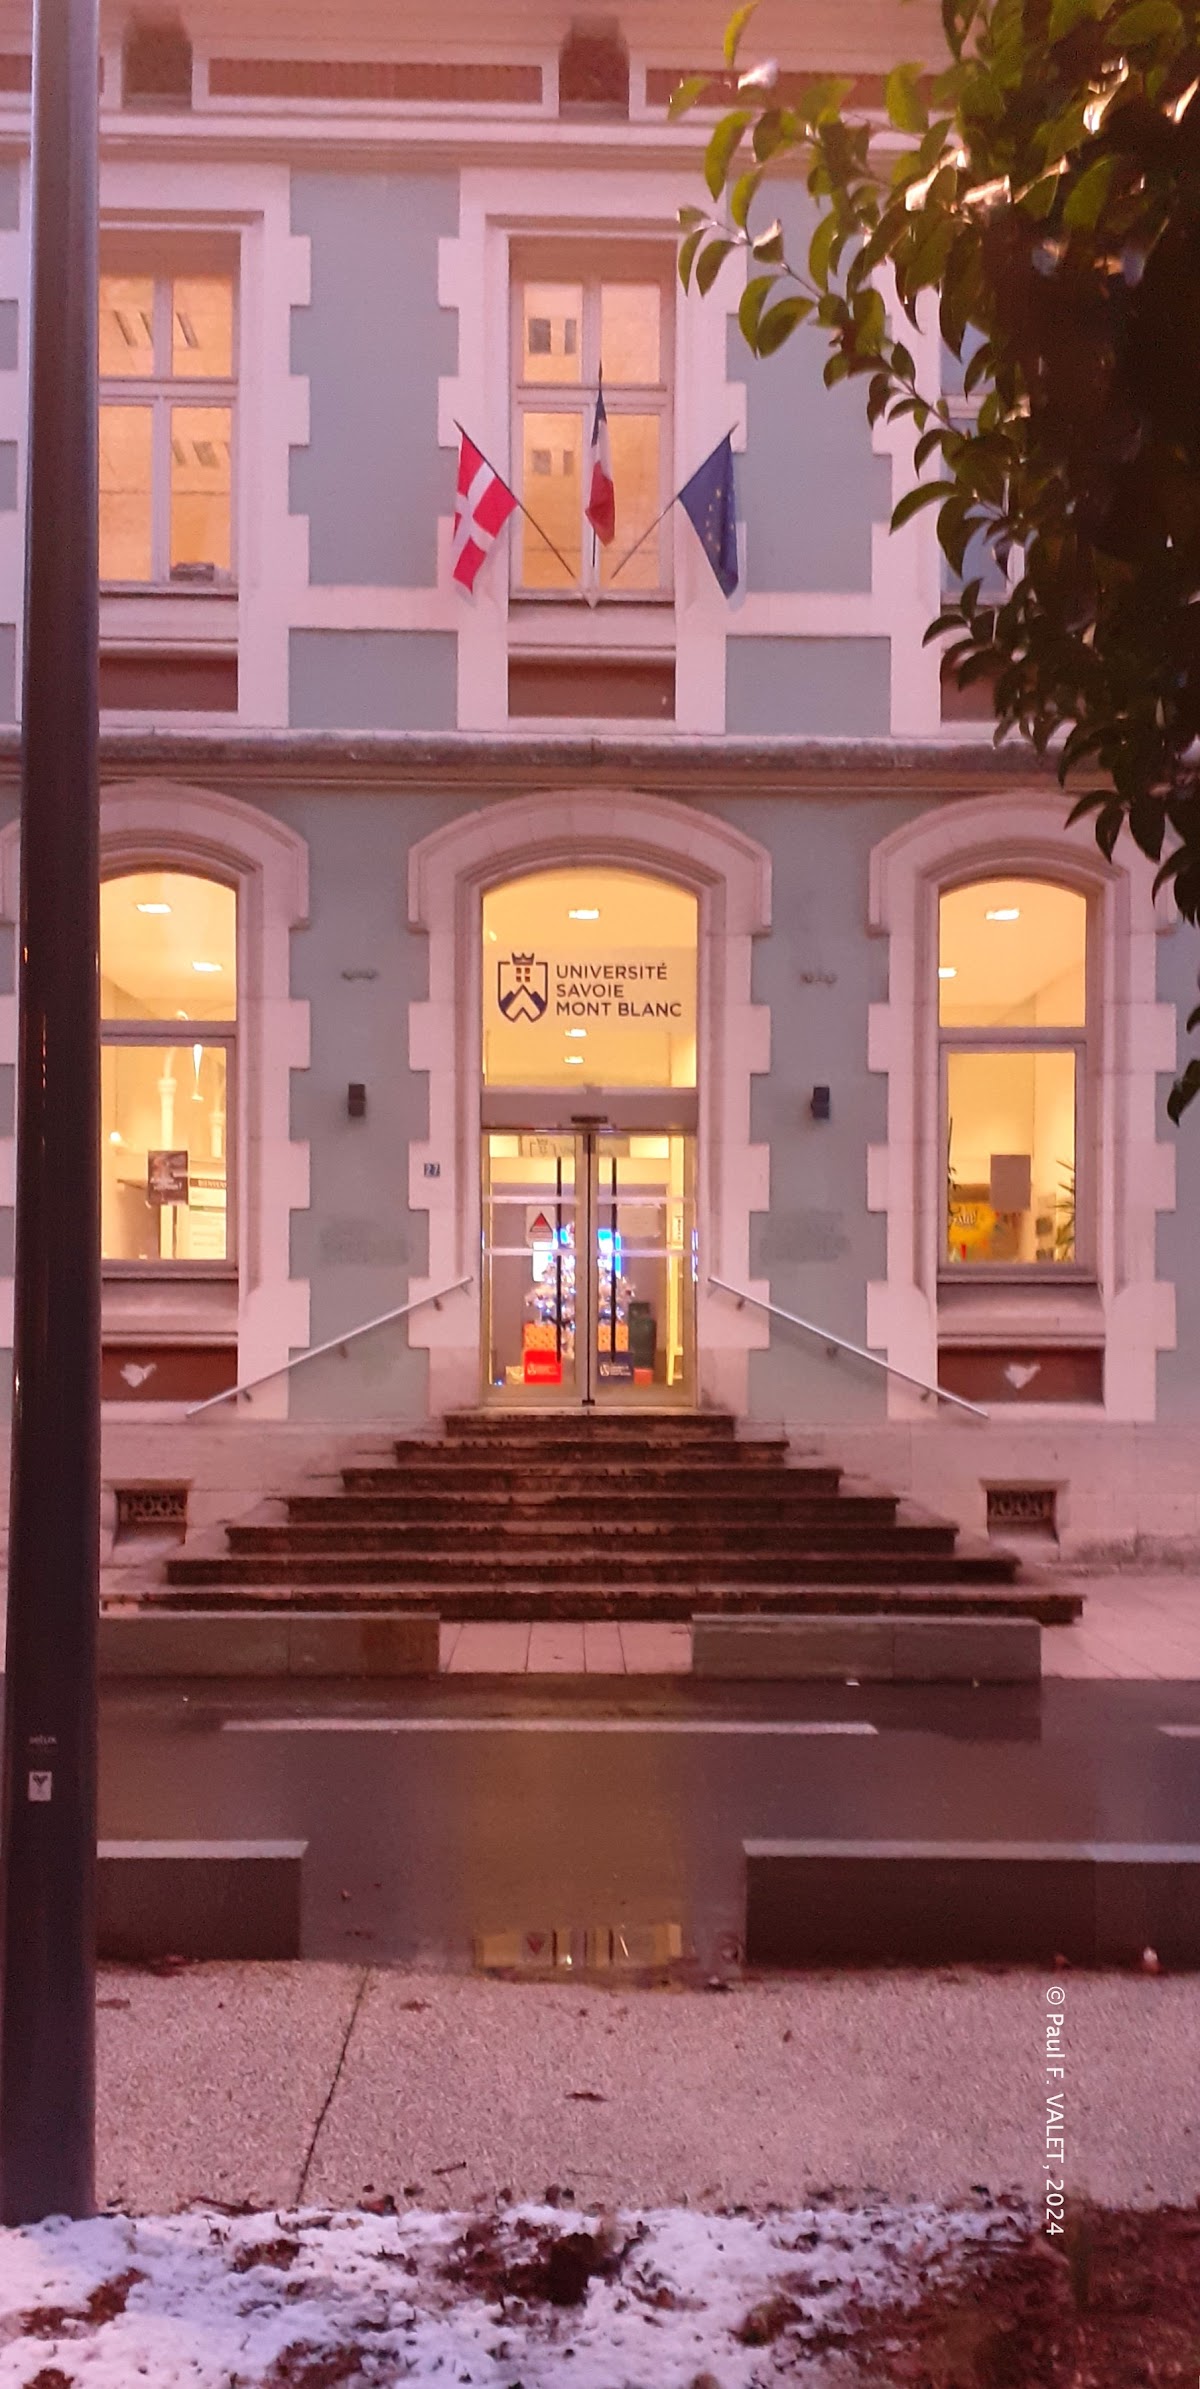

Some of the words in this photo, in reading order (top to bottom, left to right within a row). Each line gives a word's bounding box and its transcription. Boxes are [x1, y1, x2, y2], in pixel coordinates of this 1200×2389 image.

[556, 962, 668, 980] UNIVERSITÉ
[556, 983, 625, 998] SAVOIE
[556, 1002, 612, 1017] MONT
[618, 1002, 683, 1018] BLANC
[425, 1163, 439, 1176] 27
